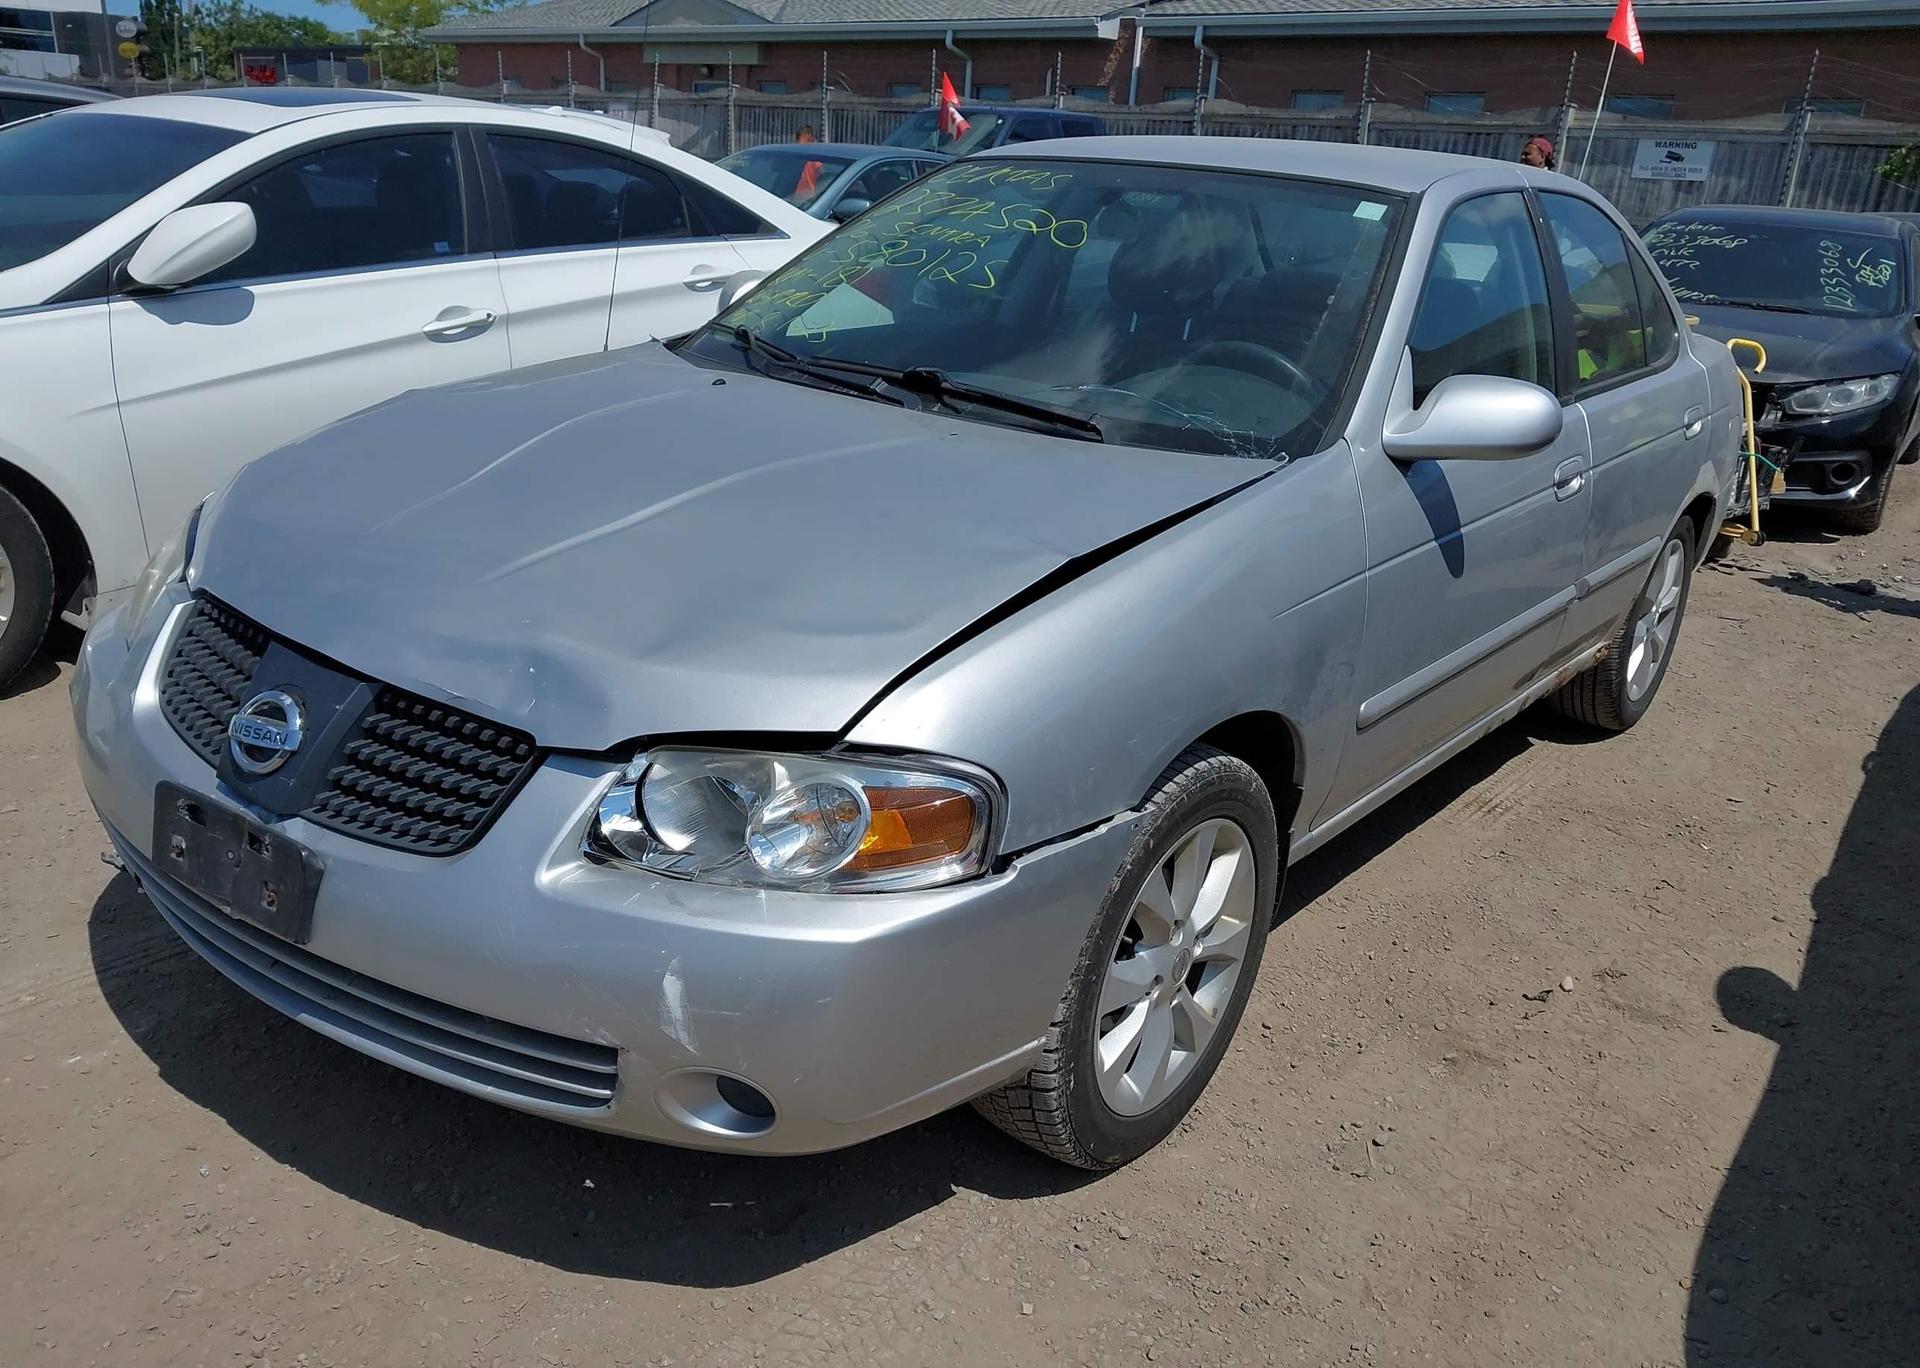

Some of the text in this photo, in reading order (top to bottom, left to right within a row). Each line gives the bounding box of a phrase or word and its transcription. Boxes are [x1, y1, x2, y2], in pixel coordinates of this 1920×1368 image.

[1654, 141, 1698, 150] WARNING
[882, 221, 991, 249] SENTRA
[231, 721, 290, 746] NISSAN
